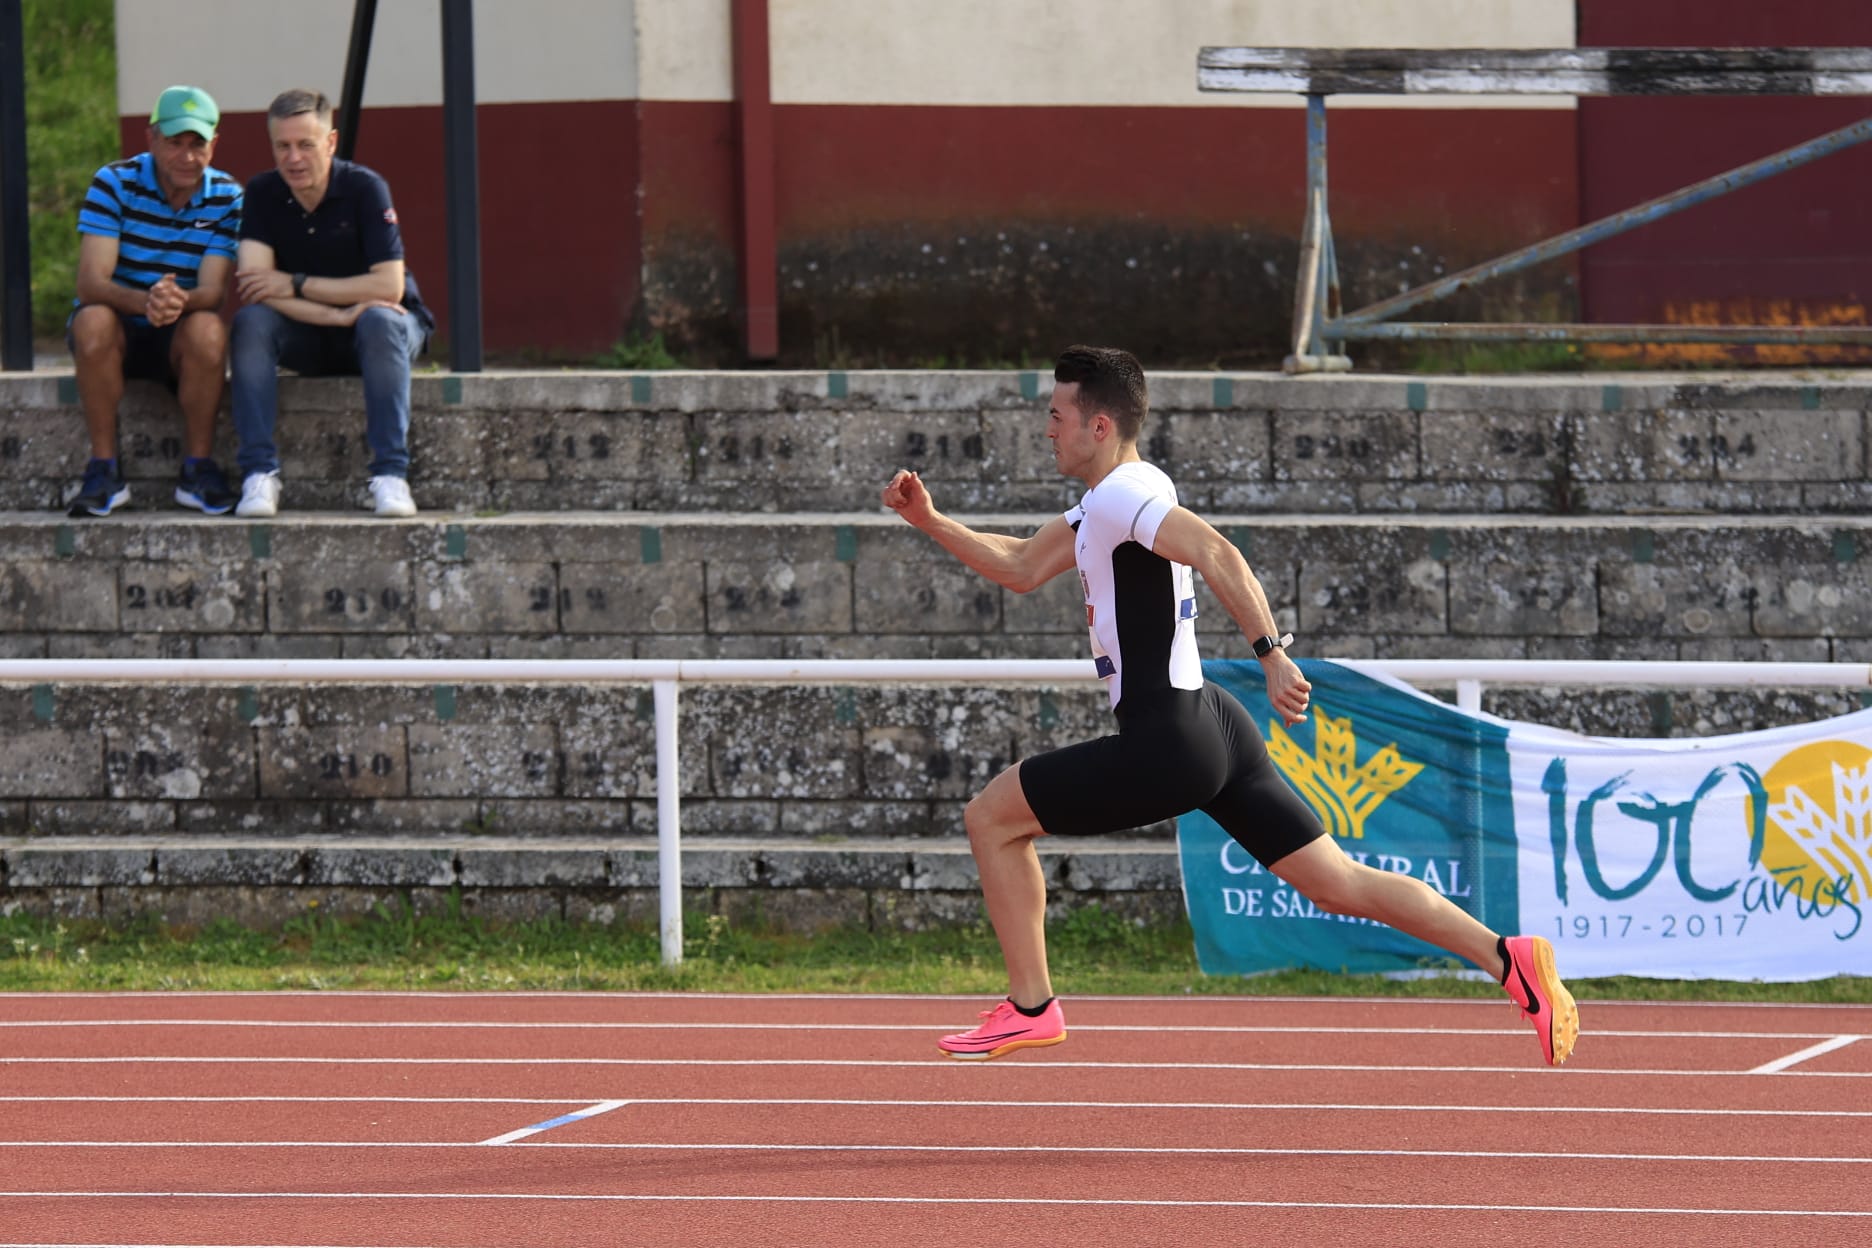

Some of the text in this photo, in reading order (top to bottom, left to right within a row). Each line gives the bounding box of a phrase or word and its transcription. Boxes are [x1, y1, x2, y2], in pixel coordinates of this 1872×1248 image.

[1541, 757, 1862, 940] 100 años
[1222, 888, 1264, 917] DE
[1555, 914, 1748, 938] 1917-2017
